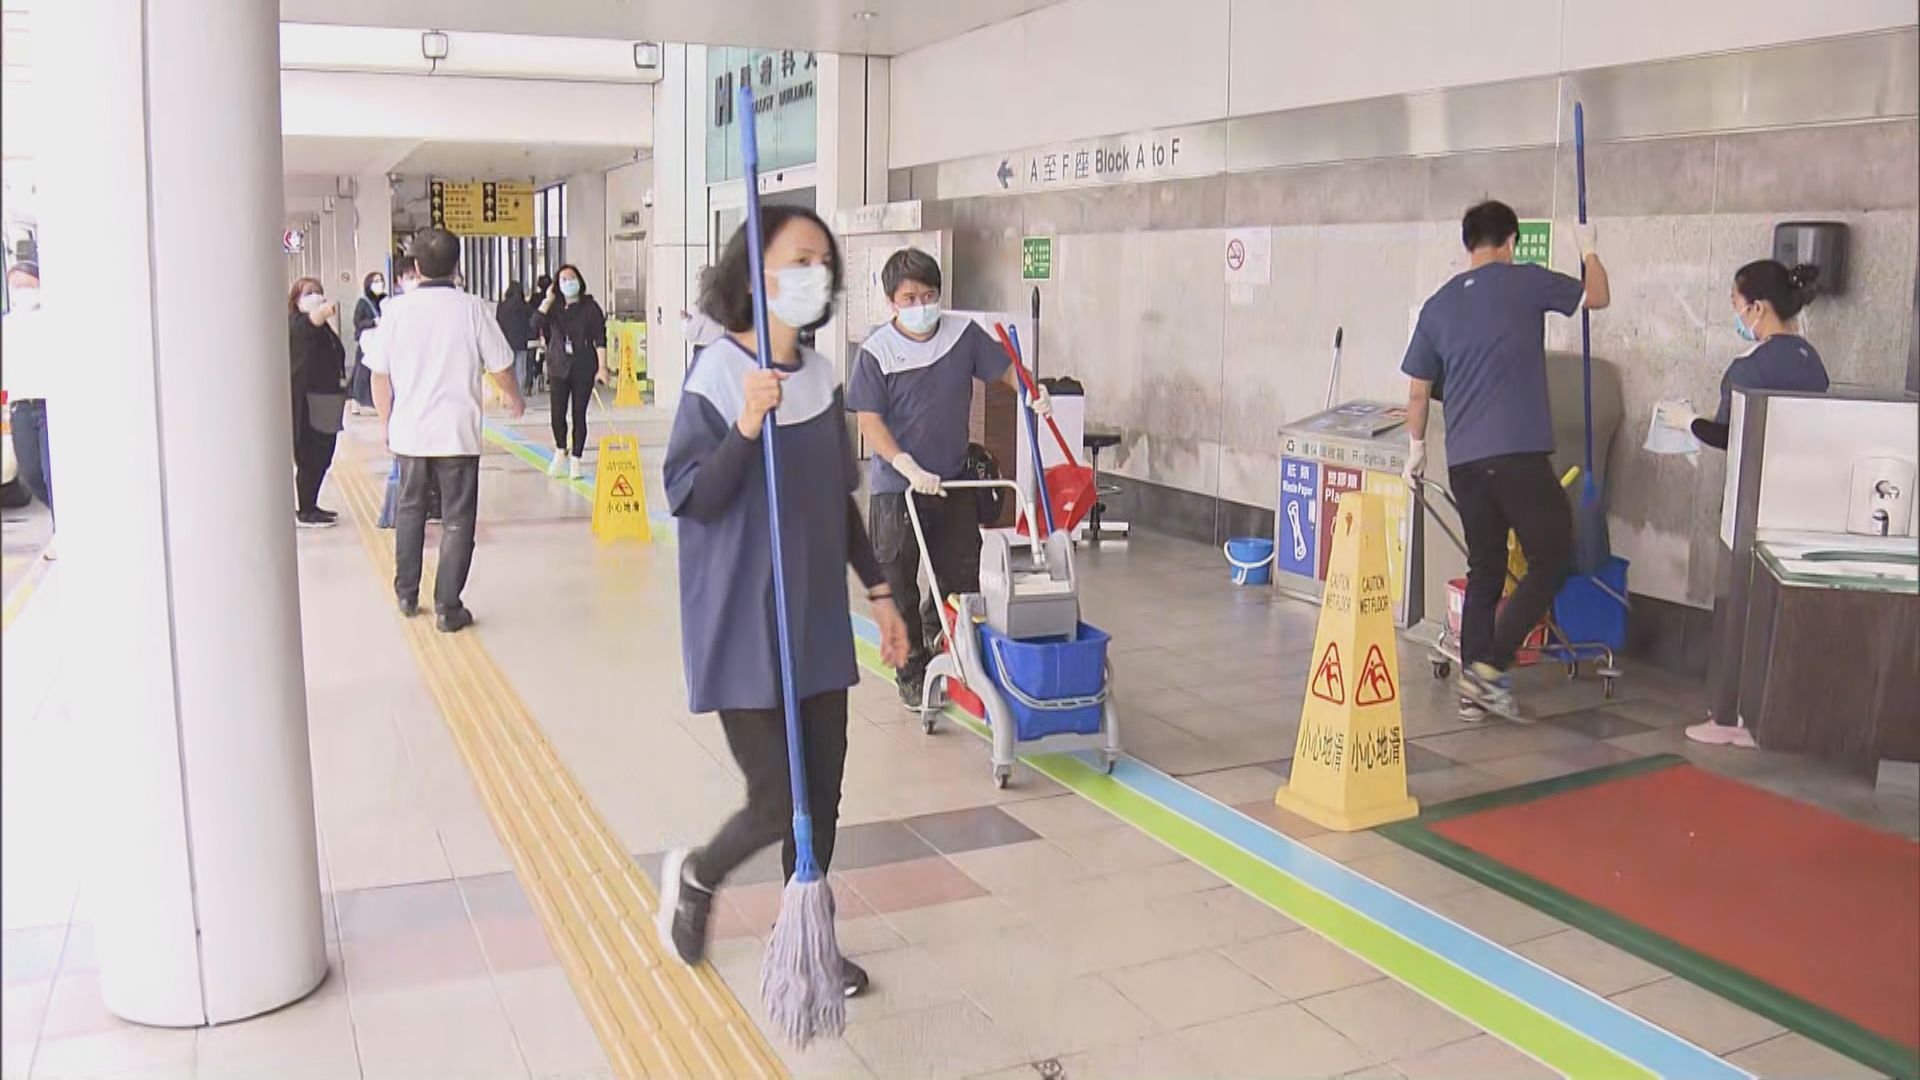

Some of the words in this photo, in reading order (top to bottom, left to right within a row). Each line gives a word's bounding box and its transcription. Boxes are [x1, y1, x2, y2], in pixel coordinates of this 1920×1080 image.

[1096, 145, 1129, 174] Block
[1136, 144, 1145, 168] A
[1152, 142, 1165, 166] to
[1172, 138, 1180, 166] F
[1298, 481, 1313, 498] Paper
[1361, 574, 1385, 593] CAUTION
[1370, 594, 1389, 615] FLOOR
[1351, 726, 1401, 773] 小心地滑
